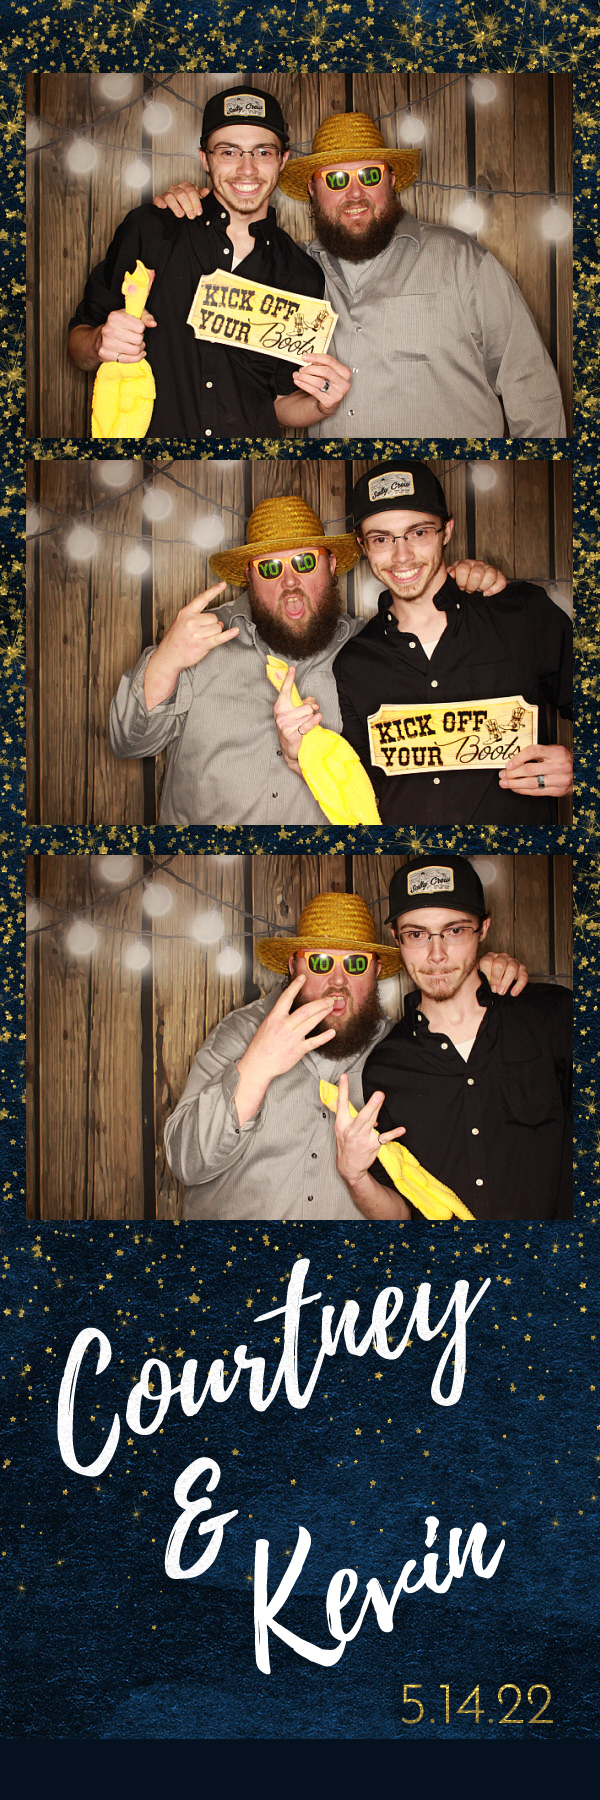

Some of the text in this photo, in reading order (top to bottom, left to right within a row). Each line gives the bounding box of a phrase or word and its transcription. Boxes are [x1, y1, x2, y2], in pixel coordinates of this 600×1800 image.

[202, 283, 300, 321] KICK OFF
[200, 308, 316, 355] YOUR Boots
[375, 710, 488, 745] KICK OFF
[380, 735, 521, 766] YOUR Boots
